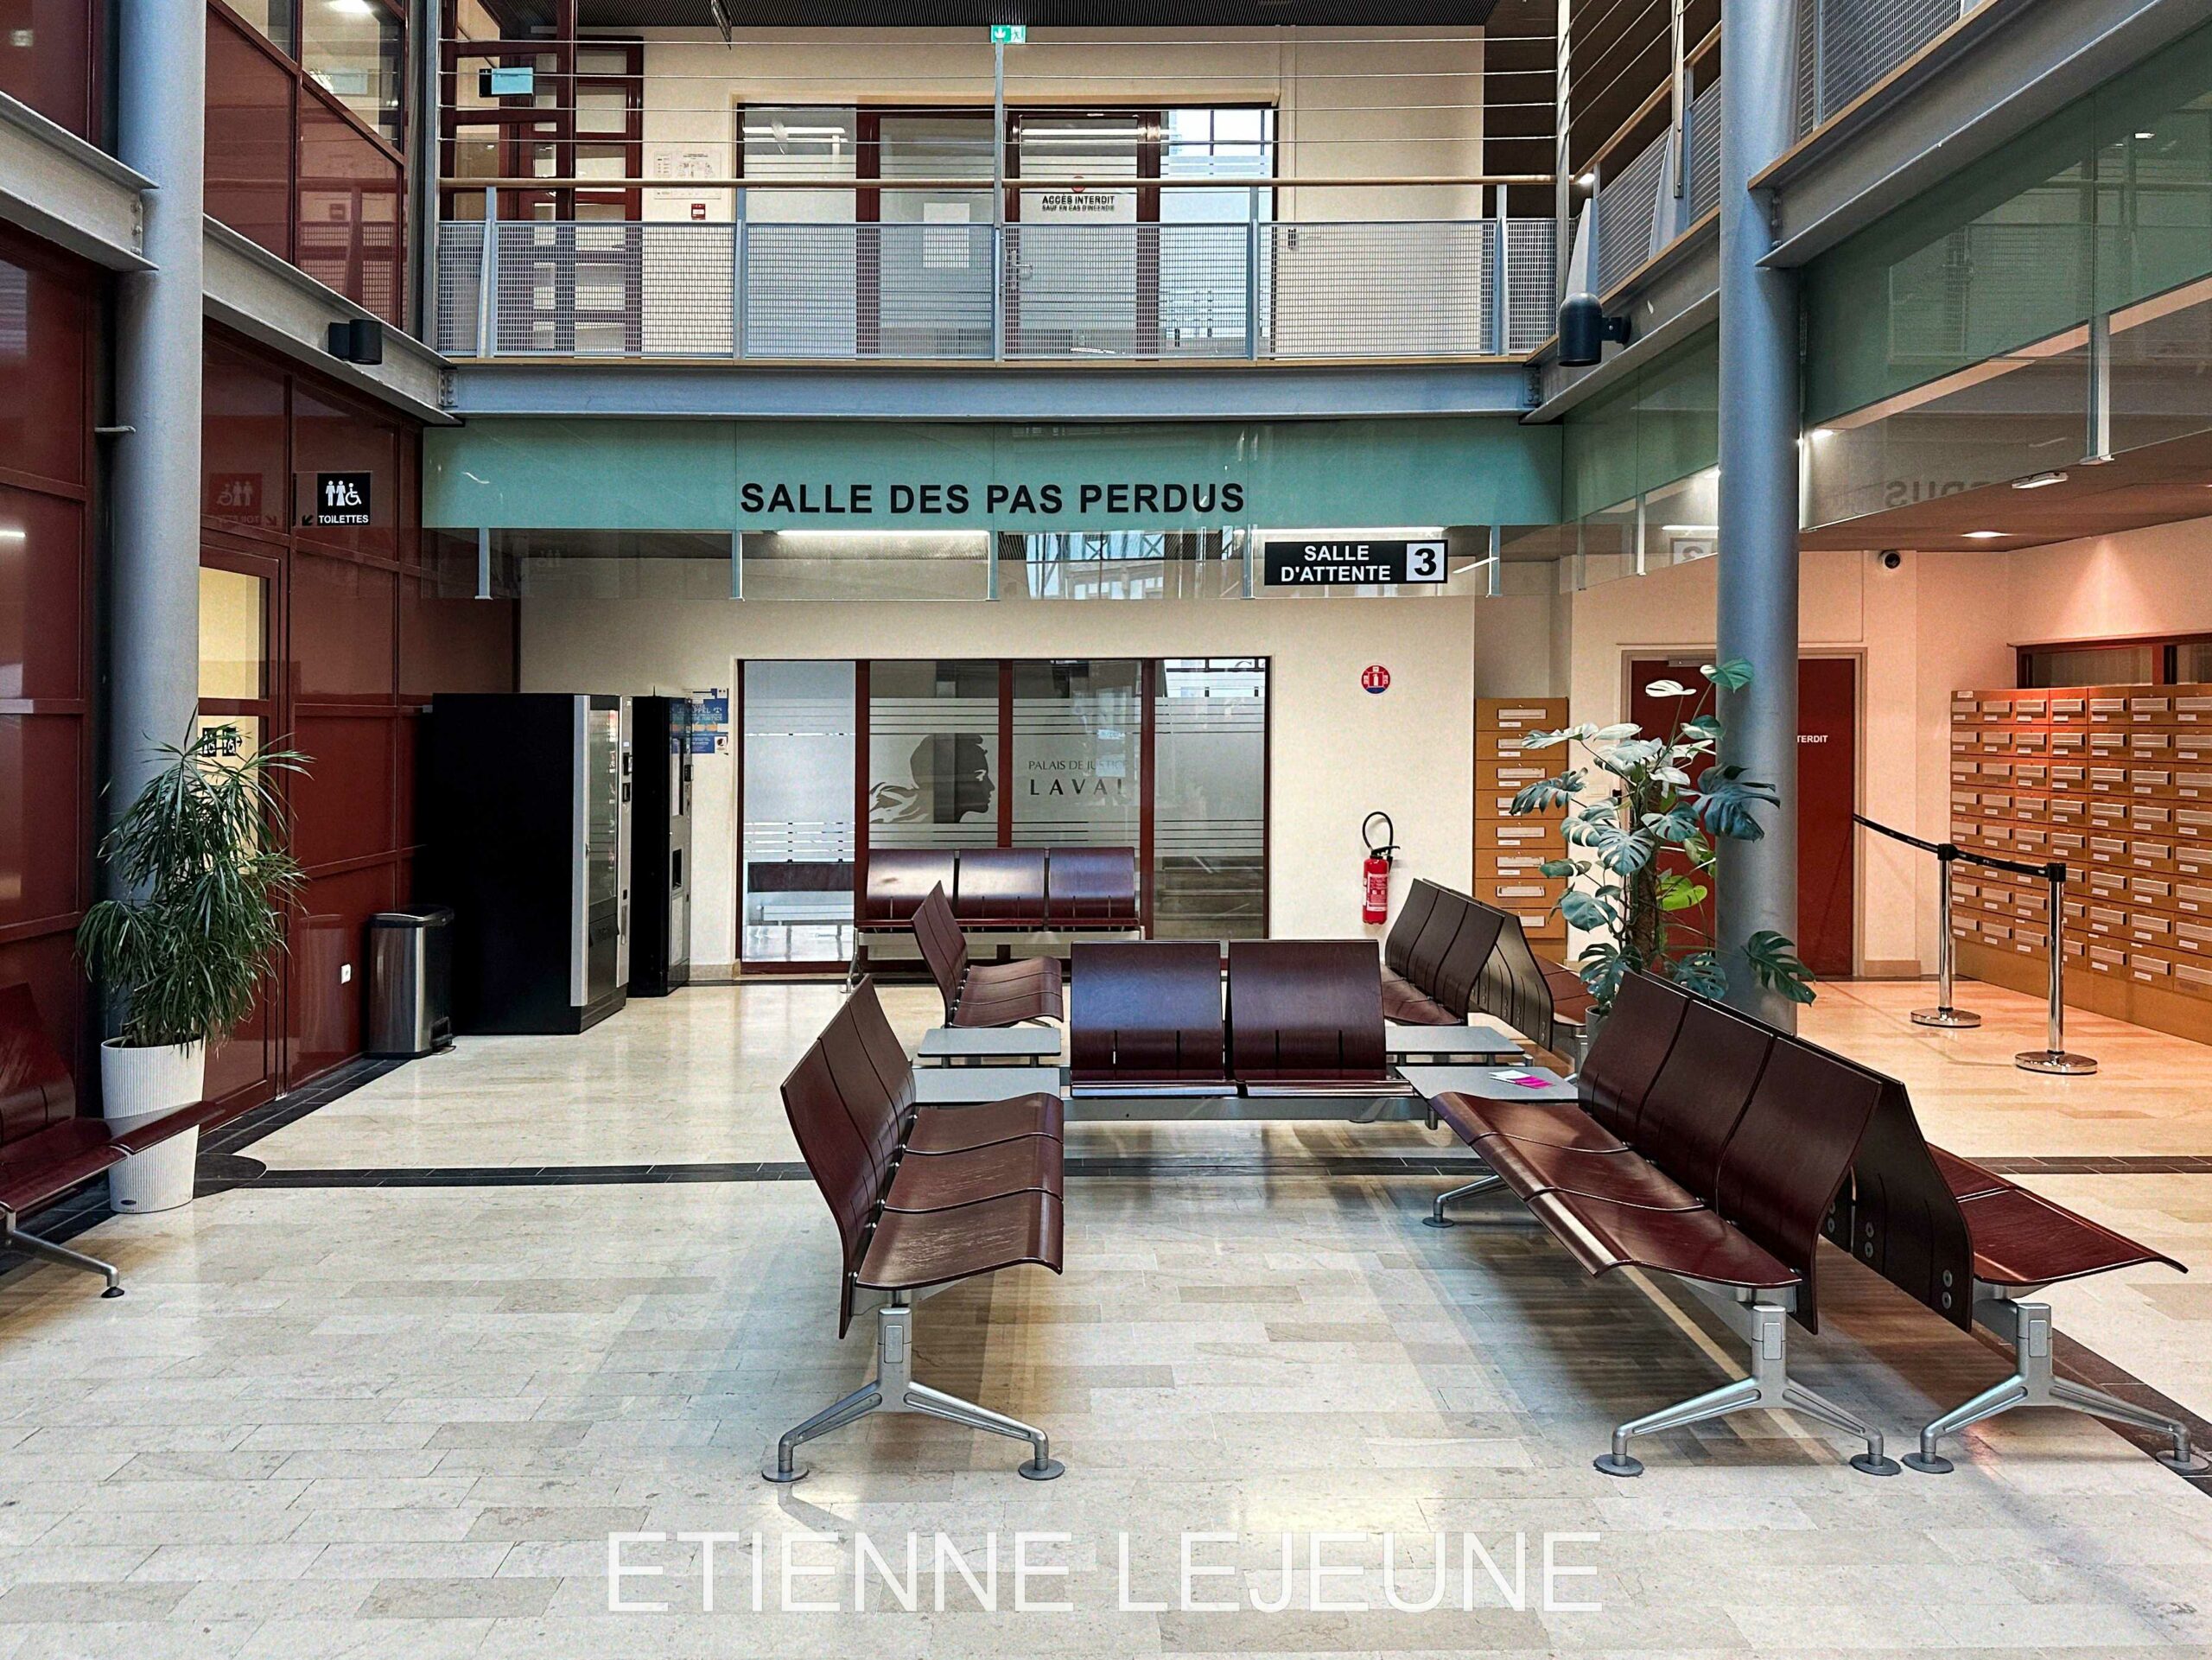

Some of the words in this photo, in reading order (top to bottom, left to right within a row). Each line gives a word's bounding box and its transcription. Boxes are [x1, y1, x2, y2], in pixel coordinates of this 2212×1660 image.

[1042, 194, 1073, 204] ACCÈS
[1075, 195, 1115, 204] INTERDIT
[741, 483, 873, 513] SALLE
[890, 484, 969, 514] DES
[987, 484, 1063, 514] PAS
[1080, 482, 1245, 513] PERDUS
[318, 514, 369, 524] TOILETTES
[1304, 544, 1370, 562] SALLE
[1414, 548, 1437, 576] 3
[1281, 565, 1391, 582] D'ATTENTE
[1028, 760, 1066, 771] PALAIS
[1069, 760, 1084, 770] DE
